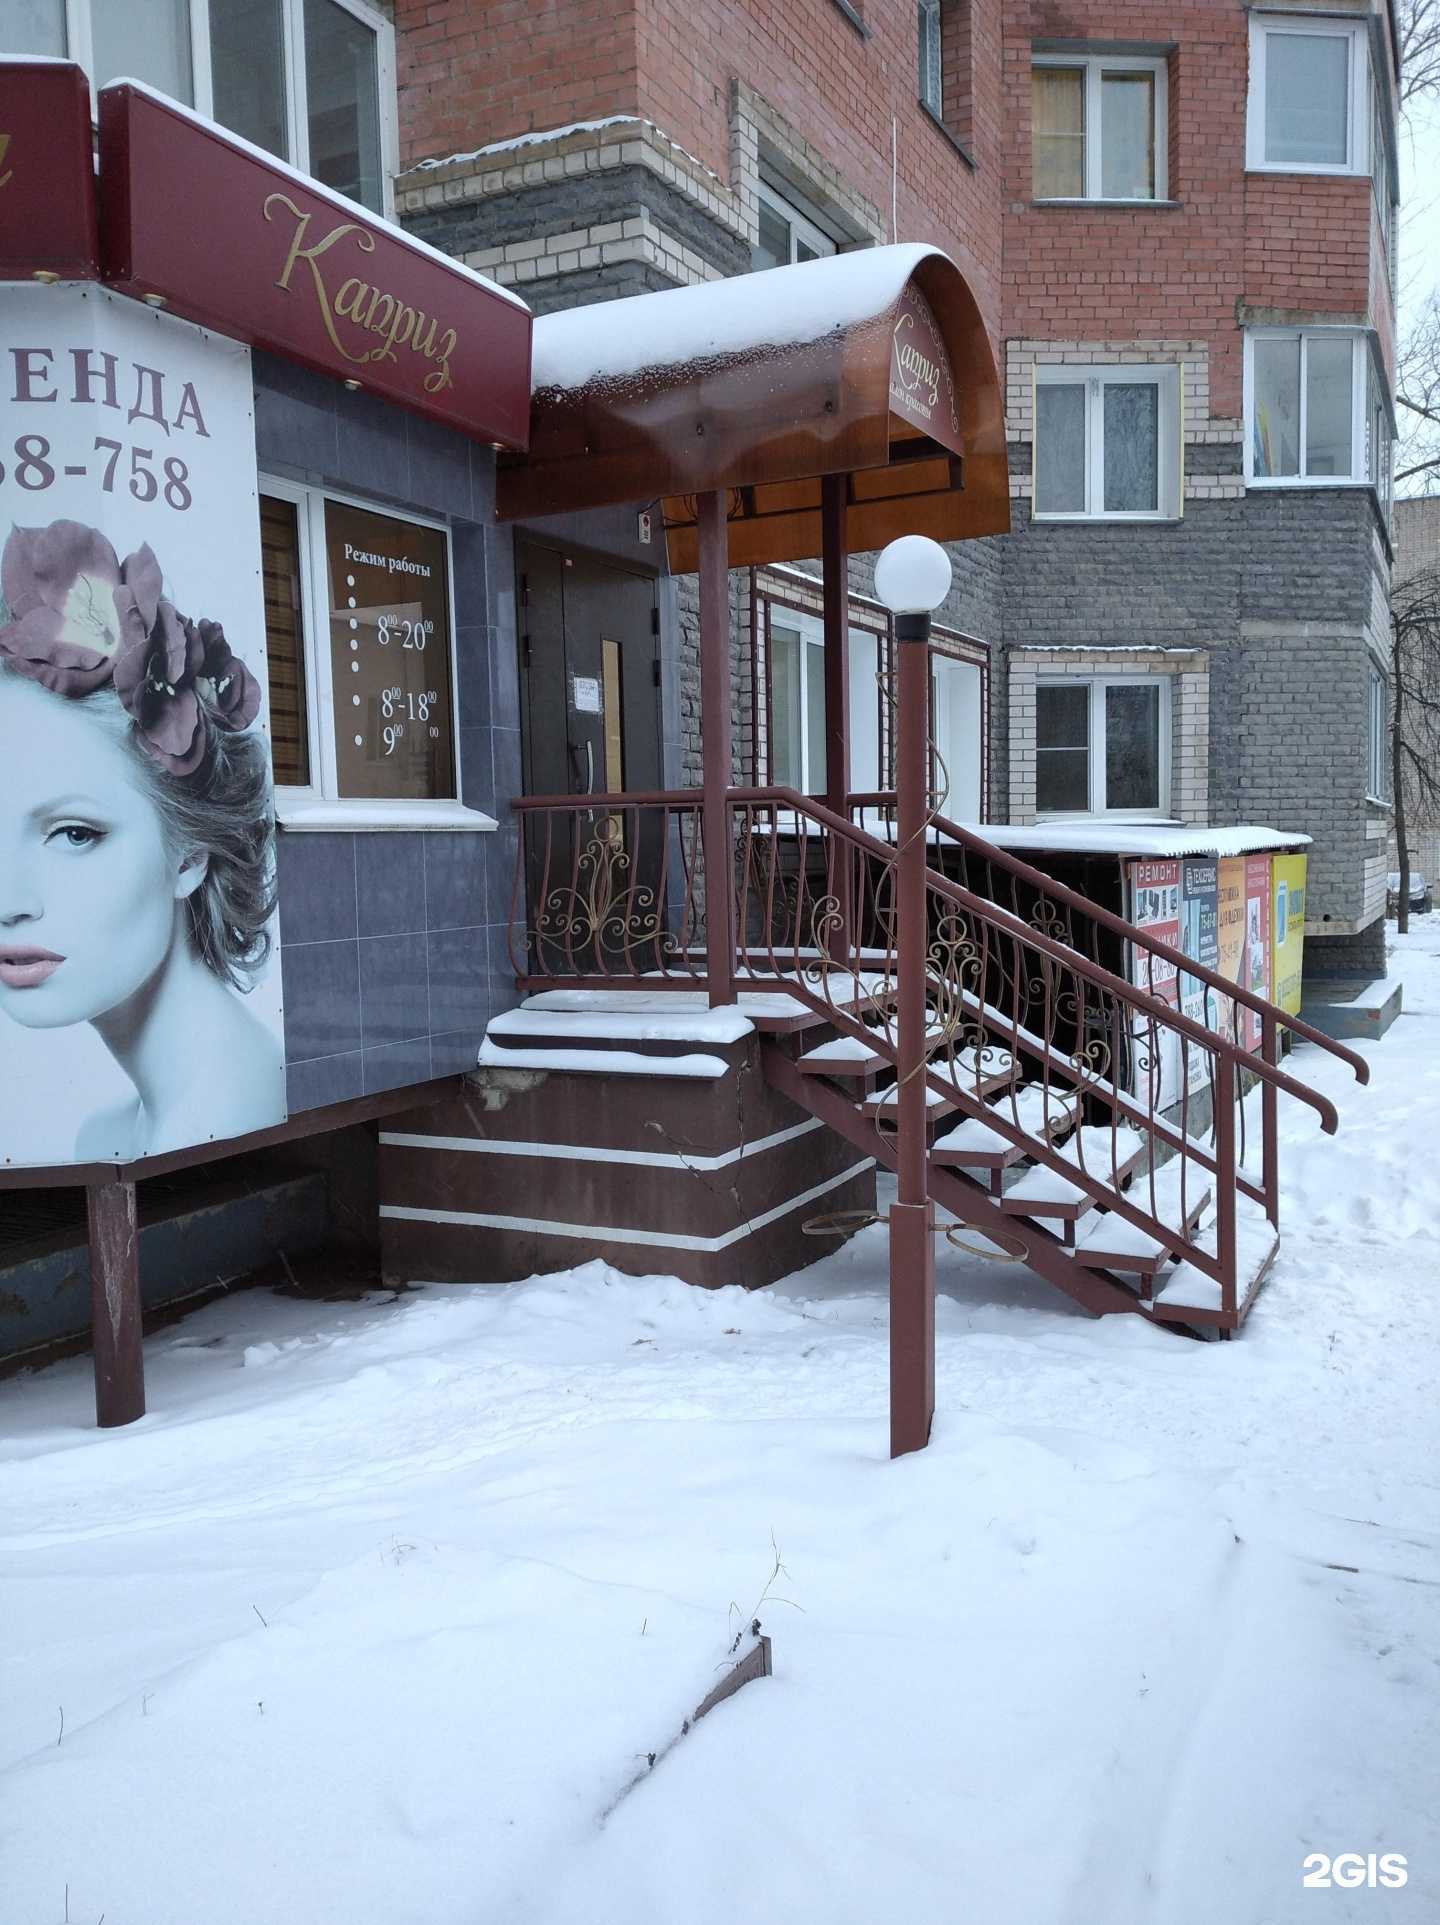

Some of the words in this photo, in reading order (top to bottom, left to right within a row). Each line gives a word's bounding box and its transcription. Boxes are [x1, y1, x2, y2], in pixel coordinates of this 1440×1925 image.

[264, 193, 457, 392] Каприз
[8, 347, 211, 438] ЕНДА
[0, 434, 193, 512] 8-758
[344, 543, 386, 567] Режим
[388, 556, 431, 577] работы
[1139, 864, 1177, 882] РЕМОНТ
